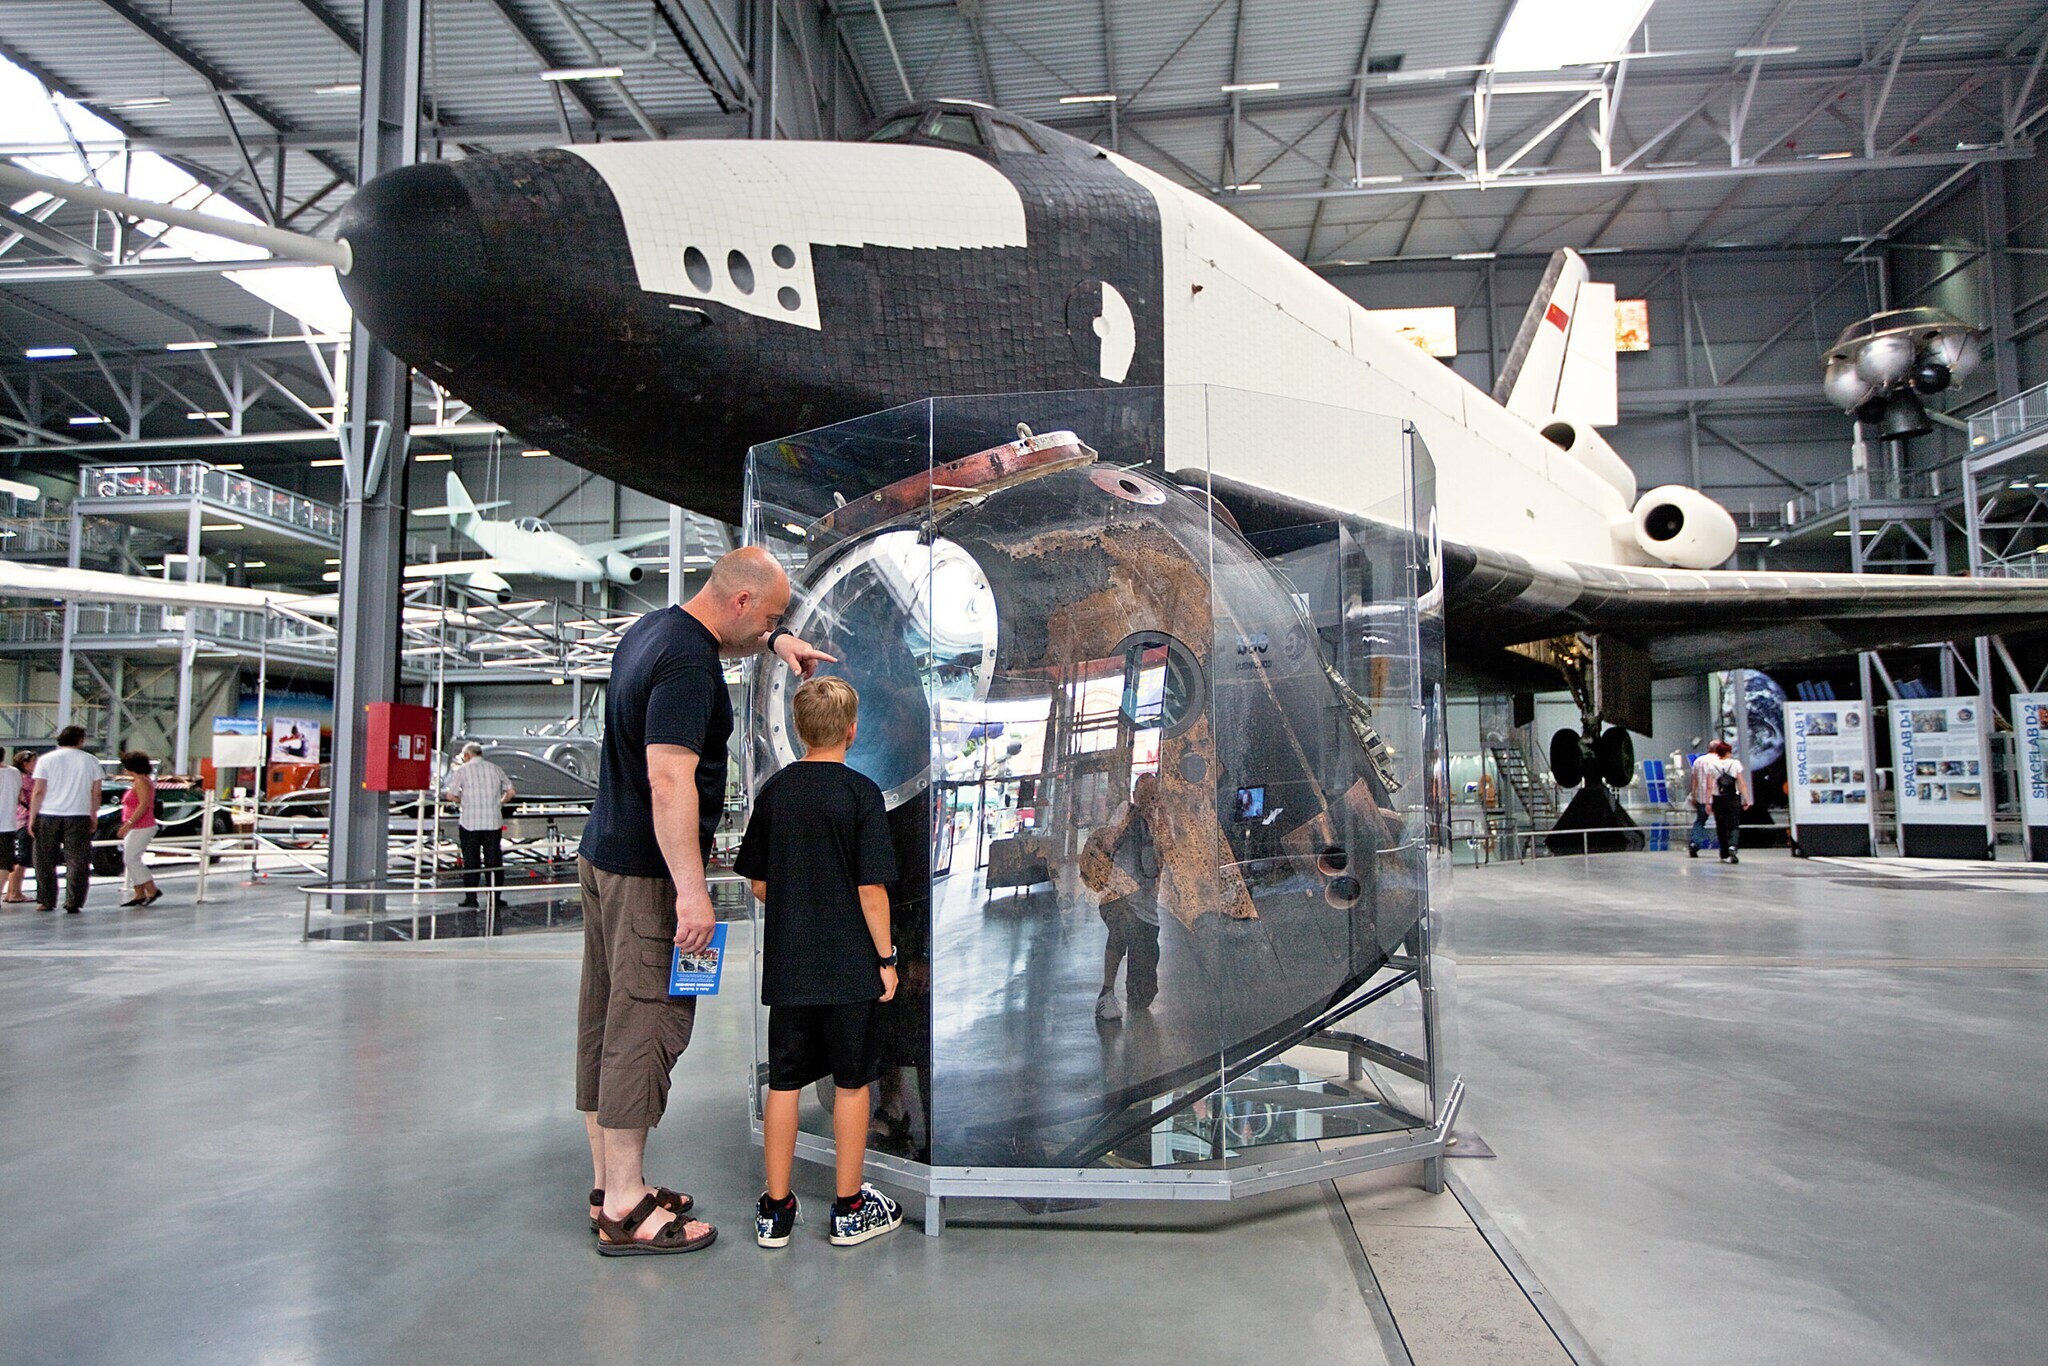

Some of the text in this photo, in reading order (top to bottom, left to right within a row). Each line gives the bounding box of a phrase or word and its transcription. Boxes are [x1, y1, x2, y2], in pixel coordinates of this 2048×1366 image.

[1899, 710, 1912, 729] D-1
[2024, 704, 2039, 725] D-2
[1795, 720, 1808, 785] SPACELAB
[1901, 731, 1917, 797] SPACELAB
[2026, 728, 2045, 799] SPACELAB
